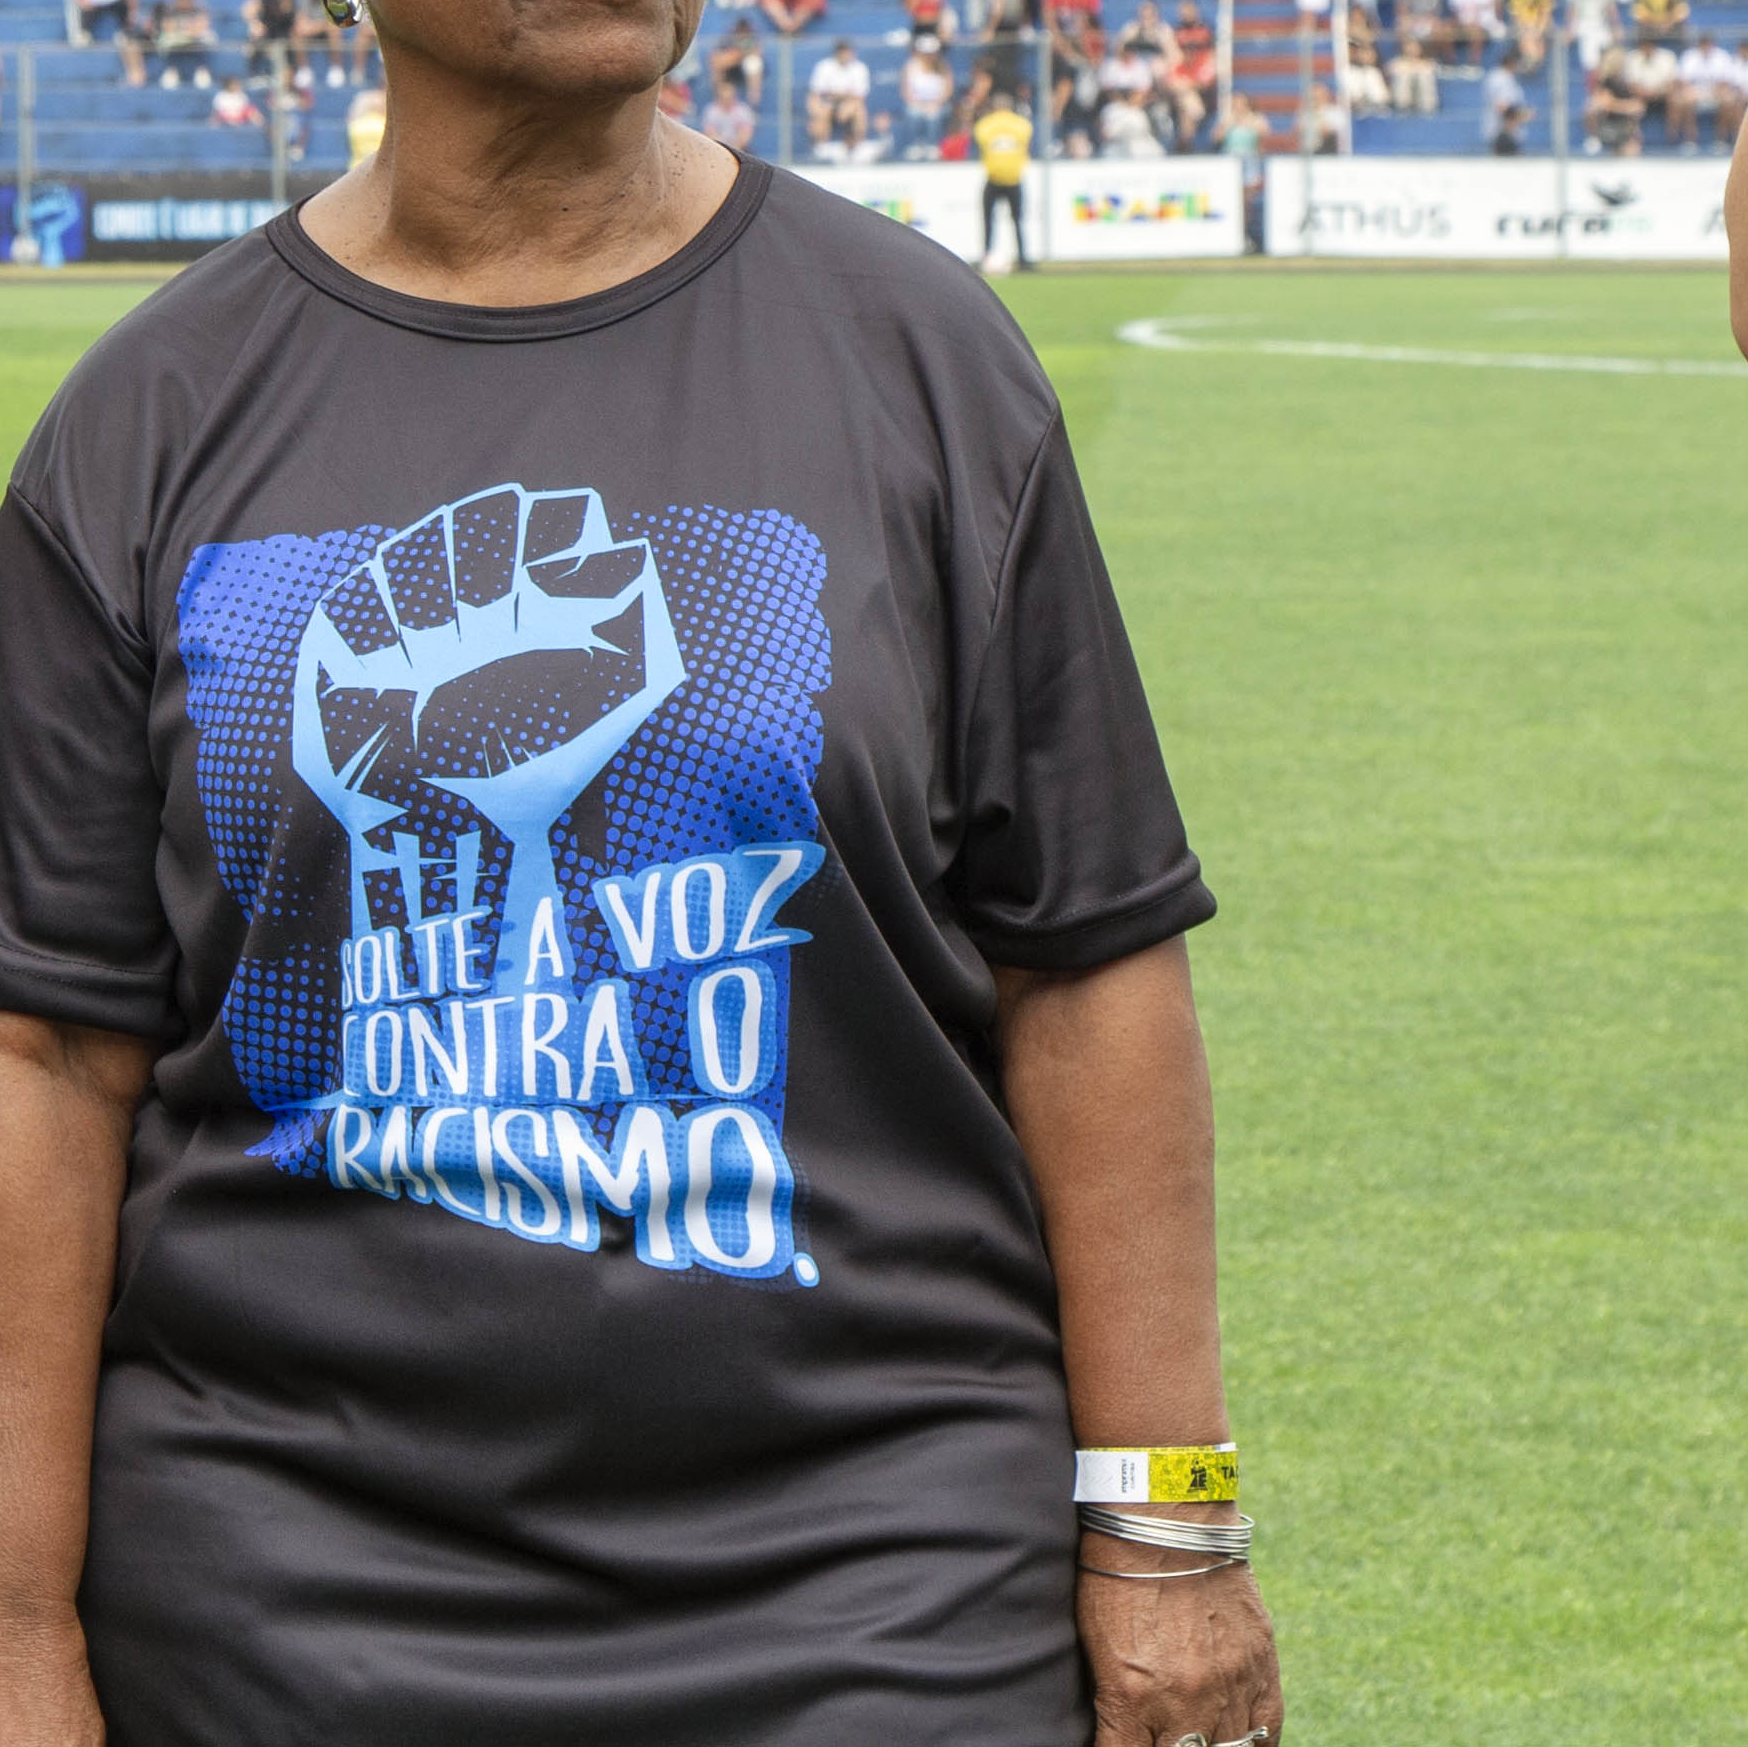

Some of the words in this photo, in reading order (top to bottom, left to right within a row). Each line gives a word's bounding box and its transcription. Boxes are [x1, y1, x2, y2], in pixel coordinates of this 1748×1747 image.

[1298, 199, 1452, 239] ATHUS
[341, 912, 491, 1011] SOLTE
[523, 896, 566, 986] A
[604, 848, 804, 970] VOZ
[342, 982, 635, 1101] CONTRA
[696, 966, 764, 1094] O
[333, 1103, 817, 1282] RACISMO.
